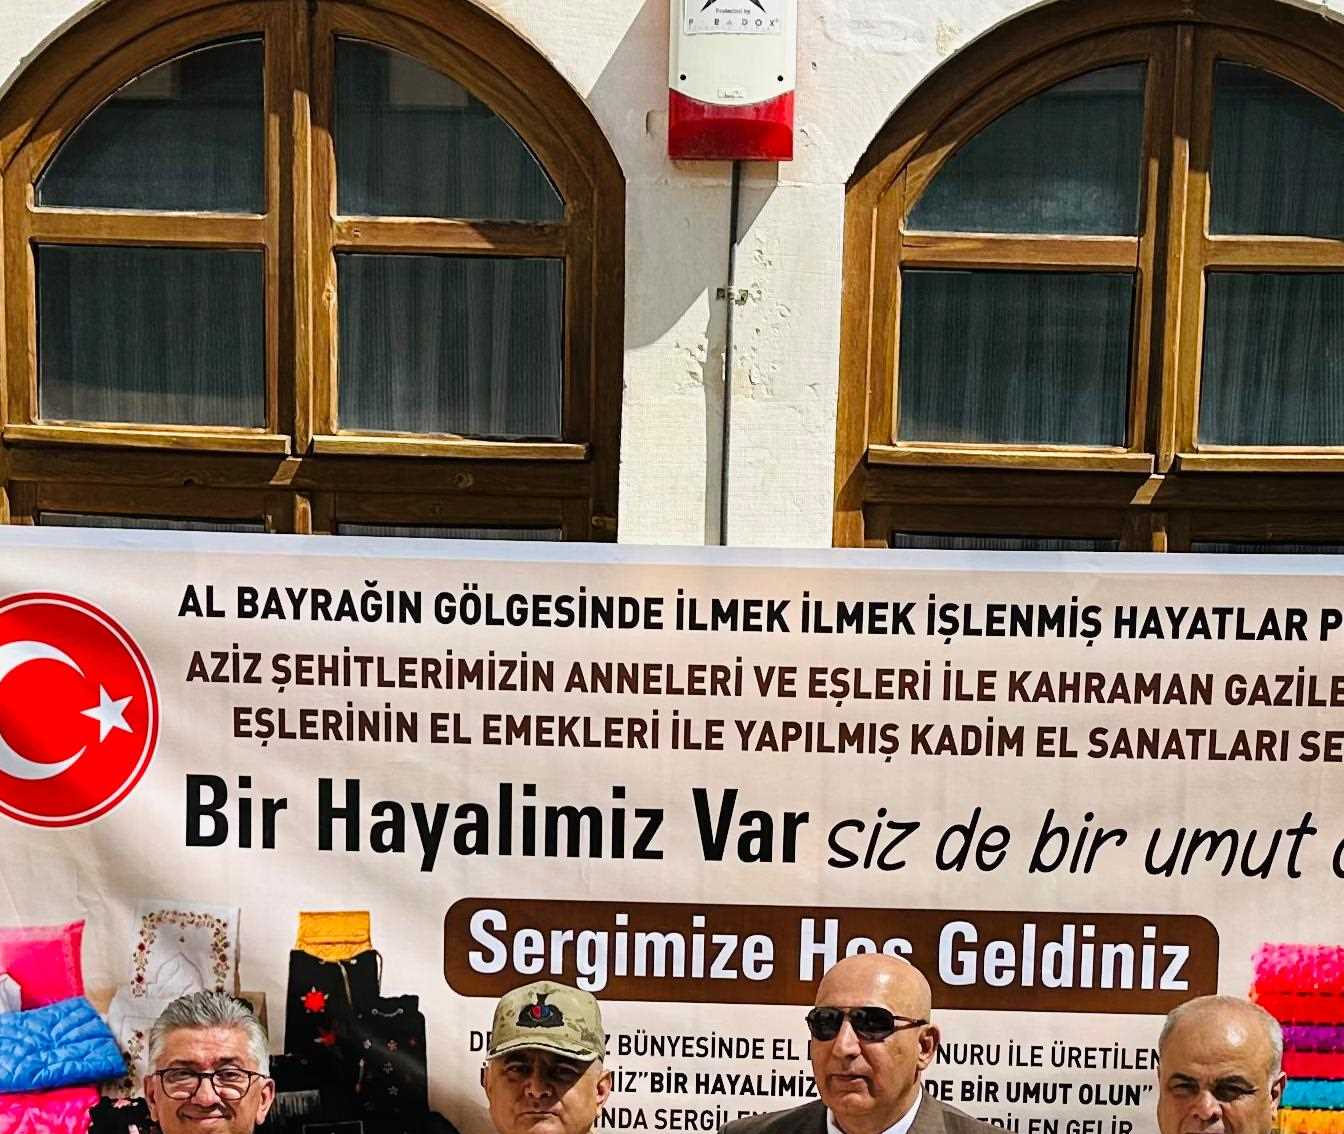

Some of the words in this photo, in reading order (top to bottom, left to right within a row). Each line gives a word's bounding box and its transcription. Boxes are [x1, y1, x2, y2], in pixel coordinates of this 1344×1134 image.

[178, 585, 225, 617] AL
[238, 580, 421, 623] BAYRAĞIN
[435, 583, 663, 629] GÖLGESİNDE
[676, 589, 790, 632] İLMEK
[802, 591, 916, 635] İLMEK
[927, 594, 1102, 647] İŞLENMİŞ
[1114, 606, 1307, 640] HAYATLAR
[186, 643, 261, 684] AZİZ
[272, 647, 554, 693] ŞEHİTLERİMİZİN
[564, 656, 742, 696] ANNELERİ
[754, 666, 797, 697] VE
[809, 660, 930, 707] EŞLERİ
[943, 661, 997, 701] İLE
[1009, 671, 1213, 705] KAHRAMAN
[234, 701, 417, 746] EŞLERİNİN
[431, 713, 471, 744] EL
[483, 709, 659, 749] EMEKLERİ
[672, 710, 724, 750] İLE
[735, 720, 899, 762] YAPILMIŞ
[911, 716, 1024, 756] KADİM
[1037, 726, 1077, 758] EL
[1088, 727, 1289, 761] SANATLARI
[186, 774, 287, 849] Bir
[319, 778, 663, 872] Hayalimiz
[692, 788, 809, 863] Var
[828, 808, 920, 871] siz
[936, 807, 1010, 871] de
[1029, 809, 1127, 873] bir
[1145, 812, 1317, 879] umut
[469, 910, 774, 992] Sergimize
[939, 921, 1189, 990] Geldiniz
[619, 1029, 764, 1059] BÜNYESİNDE
[773, 1039, 799, 1060] EL
[936, 1042, 1001, 1066] NURU
[1008, 1040, 1044, 1067] İLE
[695, 1068, 818, 1097] HAYALİMİZ
[961, 1075, 999, 1102] BİR
[1007, 1082, 1072, 1104] UMUT
